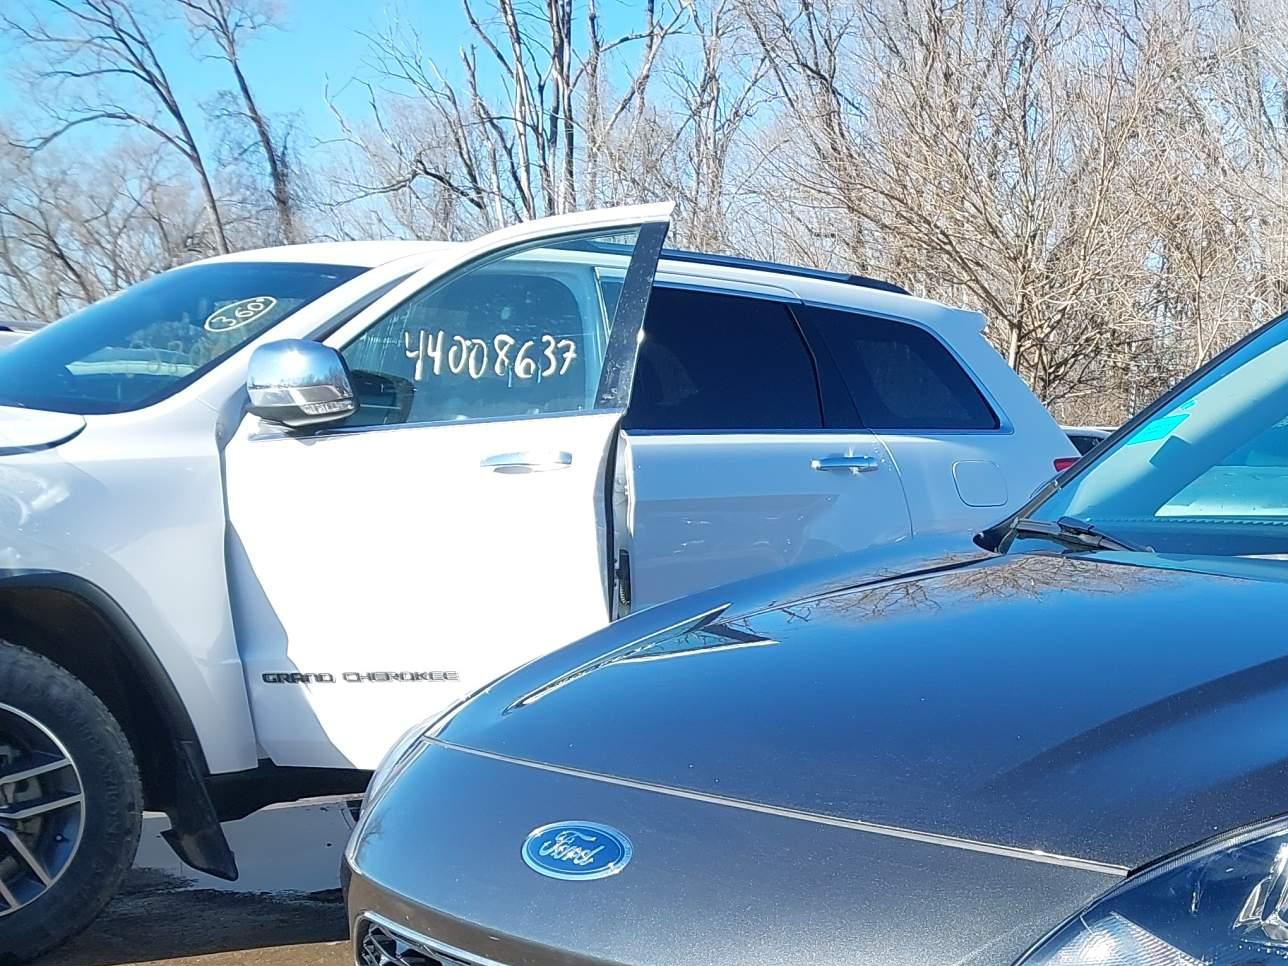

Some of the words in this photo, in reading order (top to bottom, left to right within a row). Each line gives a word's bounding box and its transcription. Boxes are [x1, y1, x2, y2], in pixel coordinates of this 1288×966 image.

[404, 329, 577, 382] 44008637
[261, 672, 336, 684] GRAND
[341, 670, 460, 684] CHEROKEE
[538, 830, 605, 866] Ford
